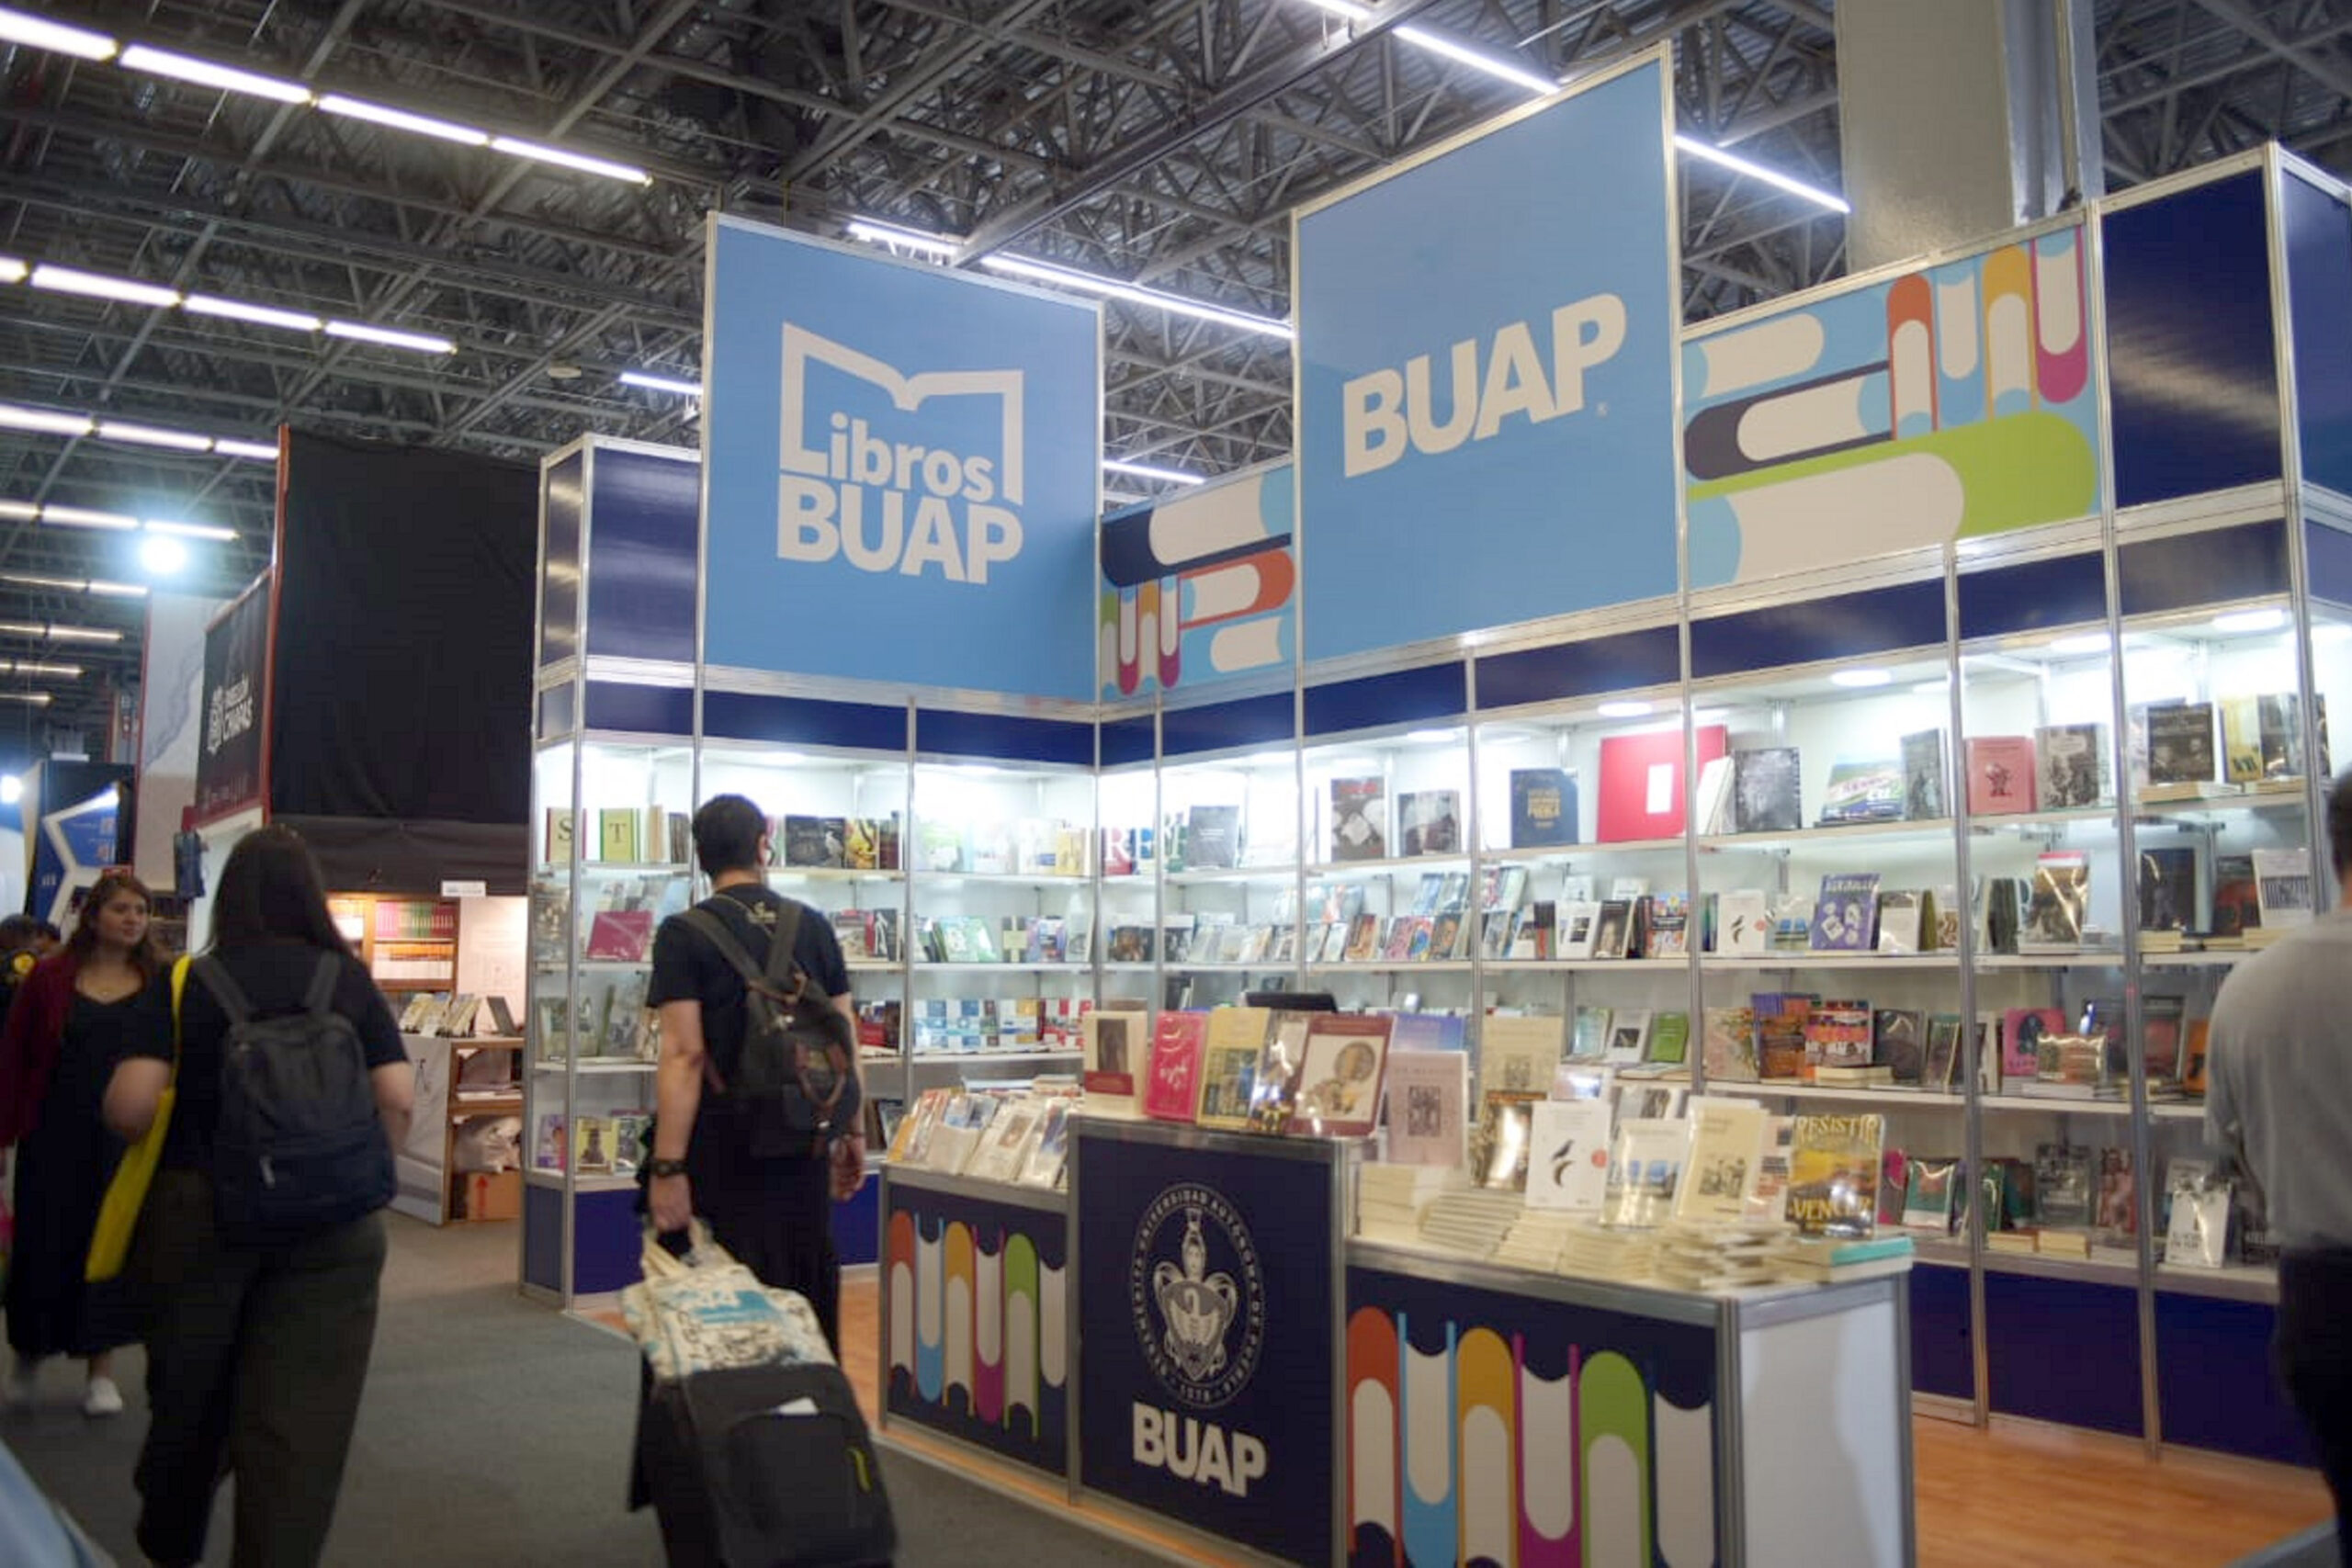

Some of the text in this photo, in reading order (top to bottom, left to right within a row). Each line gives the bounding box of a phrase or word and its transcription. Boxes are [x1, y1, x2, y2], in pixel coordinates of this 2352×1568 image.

[1343, 292, 1627, 478] BUAP
[779, 390, 995, 502] Libros
[777, 473, 1024, 585] BUAP
[609, 822, 627, 843] T
[1795, 1115, 1879, 1146] RESISTIR
[1132, 1401, 1268, 1498] BUAP
